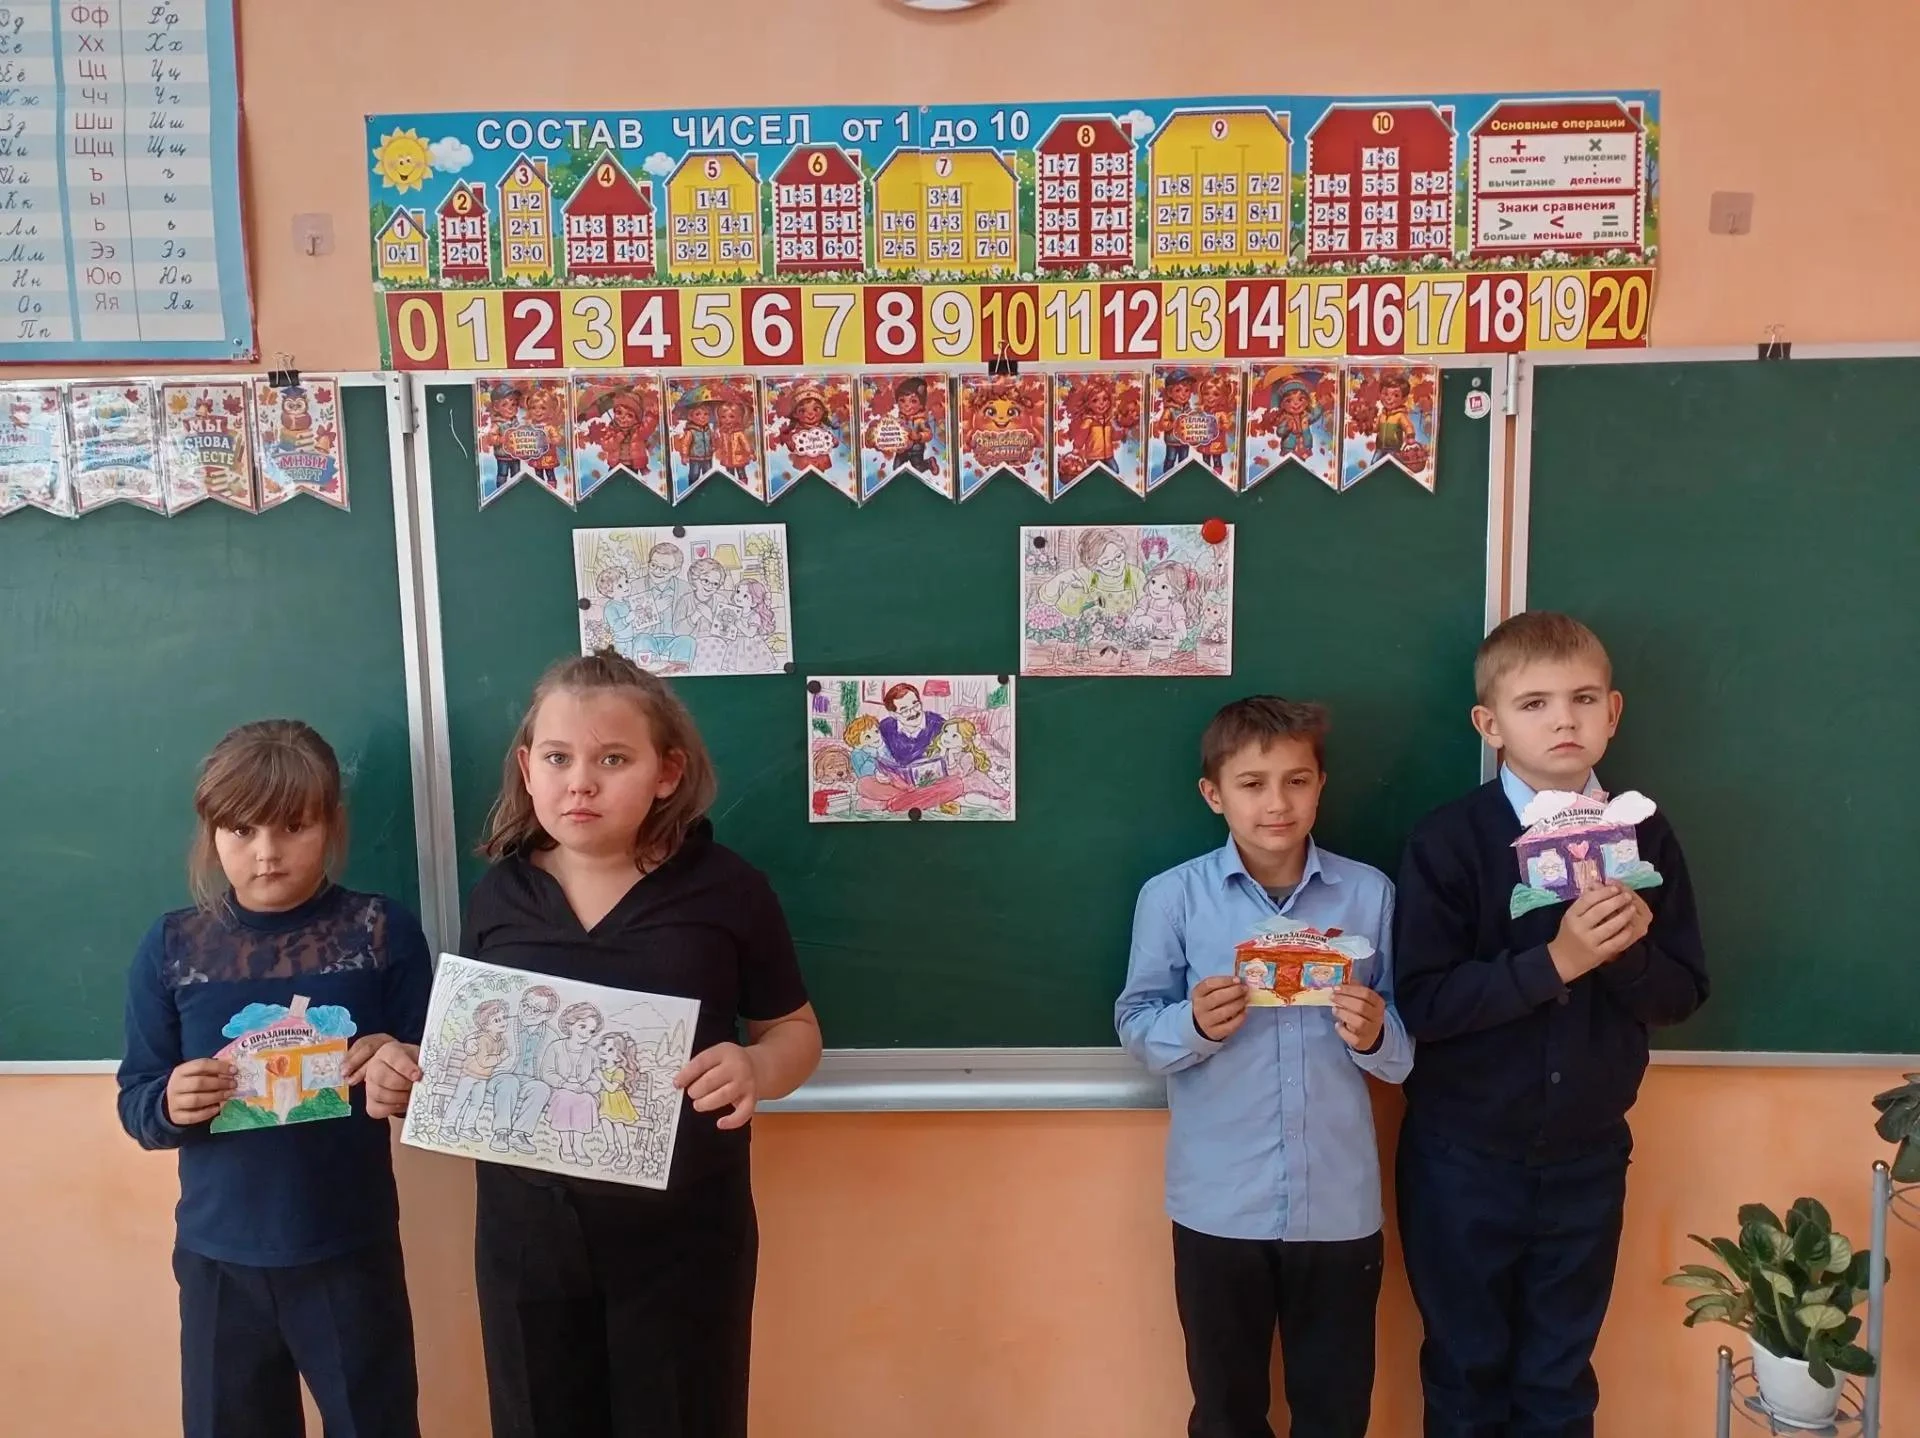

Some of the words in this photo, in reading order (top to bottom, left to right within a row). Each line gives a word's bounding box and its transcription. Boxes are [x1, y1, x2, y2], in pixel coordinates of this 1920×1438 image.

[477, 117, 644, 151] СОСТАВ
[672, 113, 811, 147] ЧИСЕЛ
[841, 118, 883, 143] от
[894, 111, 909, 142] 1
[929, 118, 978, 148] до
[990, 110, 1030, 141] 10
[1214, 120, 1224, 138] 9
[1376, 115, 1390, 131] 10
[1491, 119, 1559, 132] Основные
[1562, 118, 1626, 131] операции
[1081, 127, 1091, 145] 8
[812, 154, 823, 174] 6
[939, 158, 948, 174] 7
[1489, 154, 1546, 163] сложение
[1563, 153, 1627, 164] умножение
[518, 165, 529, 183] 3
[599, 165, 612, 183] 4
[708, 161, 717, 178] 5
[1488, 177, 1556, 188] вычитание
[1569, 176, 1622, 186] деление
[457, 193, 468, 211] 2
[1497, 201, 1540, 213] Знаки
[1543, 200, 1616, 213] сравнения
[398, 219, 407, 233] 1
[1483, 231, 1527, 242] больше
[1533, 229, 1583, 241] меньше
[1593, 228, 1629, 241] равно
[398, 298, 438, 361] 0
[457, 297, 489, 362] 1
[513, 298, 556, 360] 2
[572, 295, 616, 360] 3
[627, 296, 671, 358] 4
[691, 293, 734, 358] 5
[751, 293, 794, 357] 6
[812, 293, 856, 358] 7
[875, 292, 917, 355] 8
[930, 290, 974, 356] 9
[982, 292, 1036, 355] 10
[1045, 290, 1091, 355] 11
[1104, 289, 1159, 353] 12
[1165, 286, 1222, 352] 13
[1228, 286, 1284, 350] 14
[1289, 284, 1344, 348] 15
[1348, 283, 1403, 347] 16
[1407, 281, 1464, 346] 17
[1469, 279, 1524, 343] 18
[1529, 276, 1586, 342] 19
[1588, 276, 1648, 341] 20
[188, 419, 222, 433] МЫ
[185, 436, 230, 449] СНОВА
[241, 1039, 249, 1048] С
[249, 1028, 313, 1044] ПРАЗДНИКОМ!
